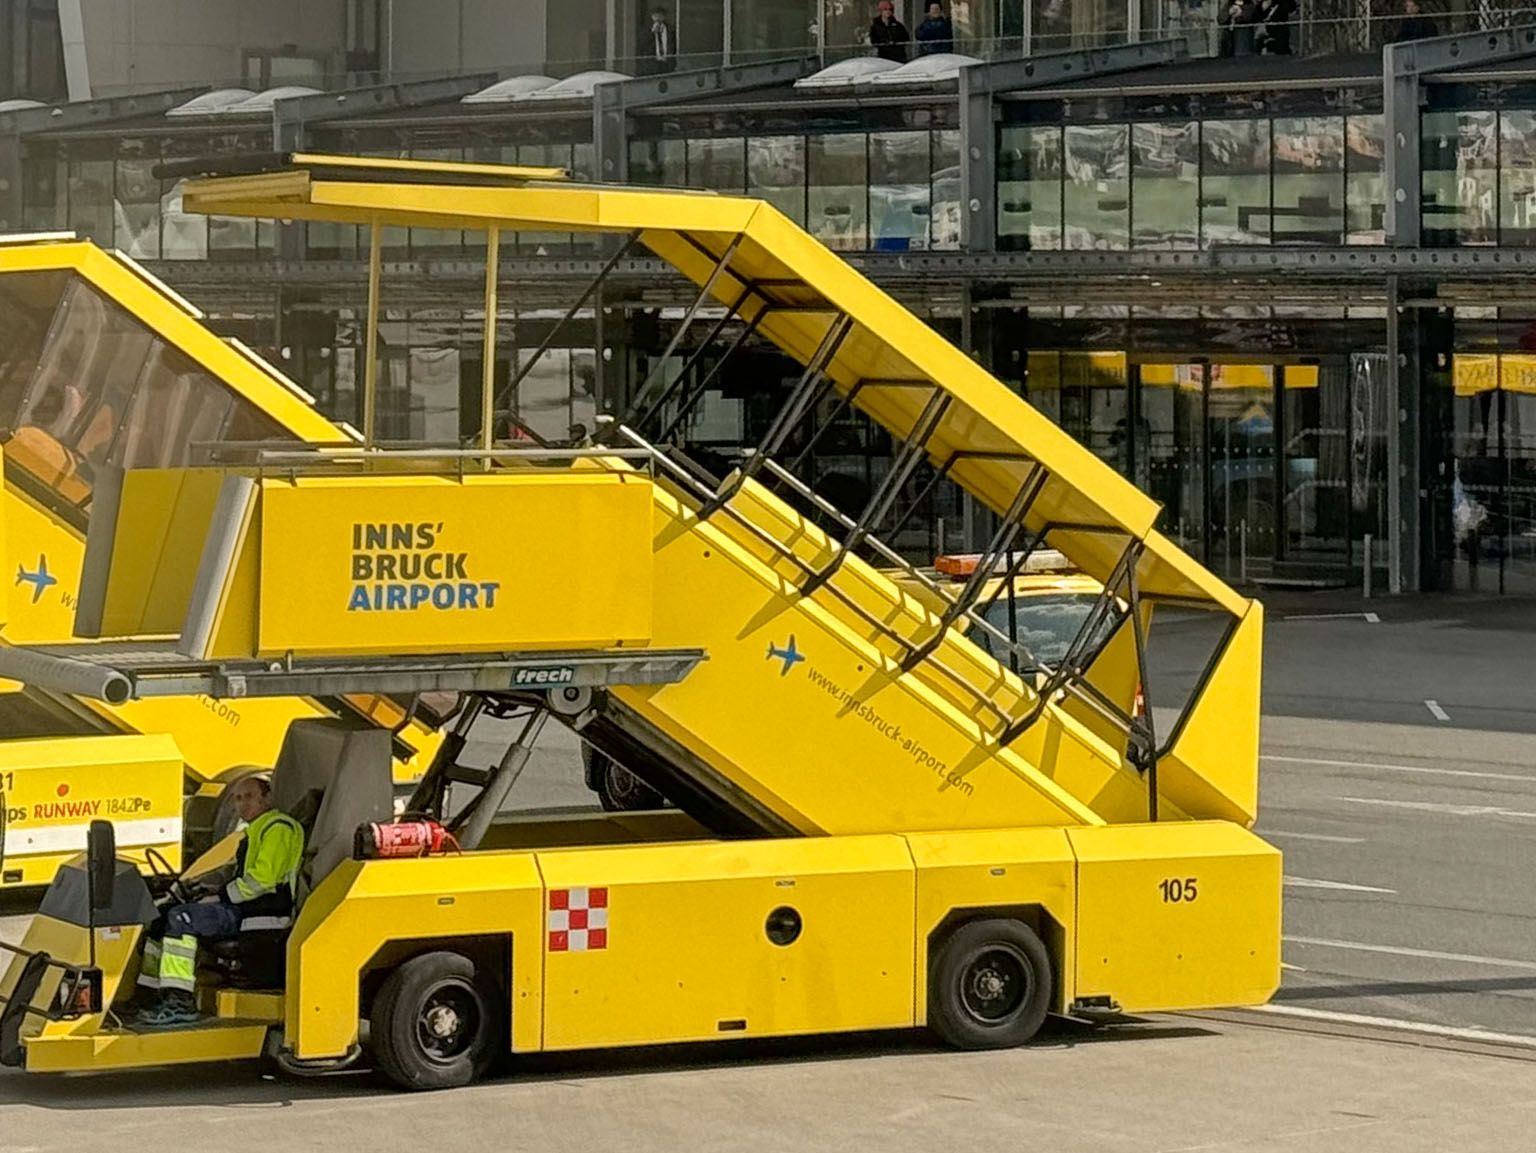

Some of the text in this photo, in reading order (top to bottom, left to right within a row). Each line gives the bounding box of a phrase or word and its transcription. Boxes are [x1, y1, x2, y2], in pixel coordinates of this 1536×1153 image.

[352, 553, 468, 580] BRUCK
[347, 583, 500, 611] AIRPORT
[807, 666, 976, 797] www.innsbruck-airport.com
[34, 800, 101, 819] RUNWAY
[1158, 877, 1198, 903] 105
